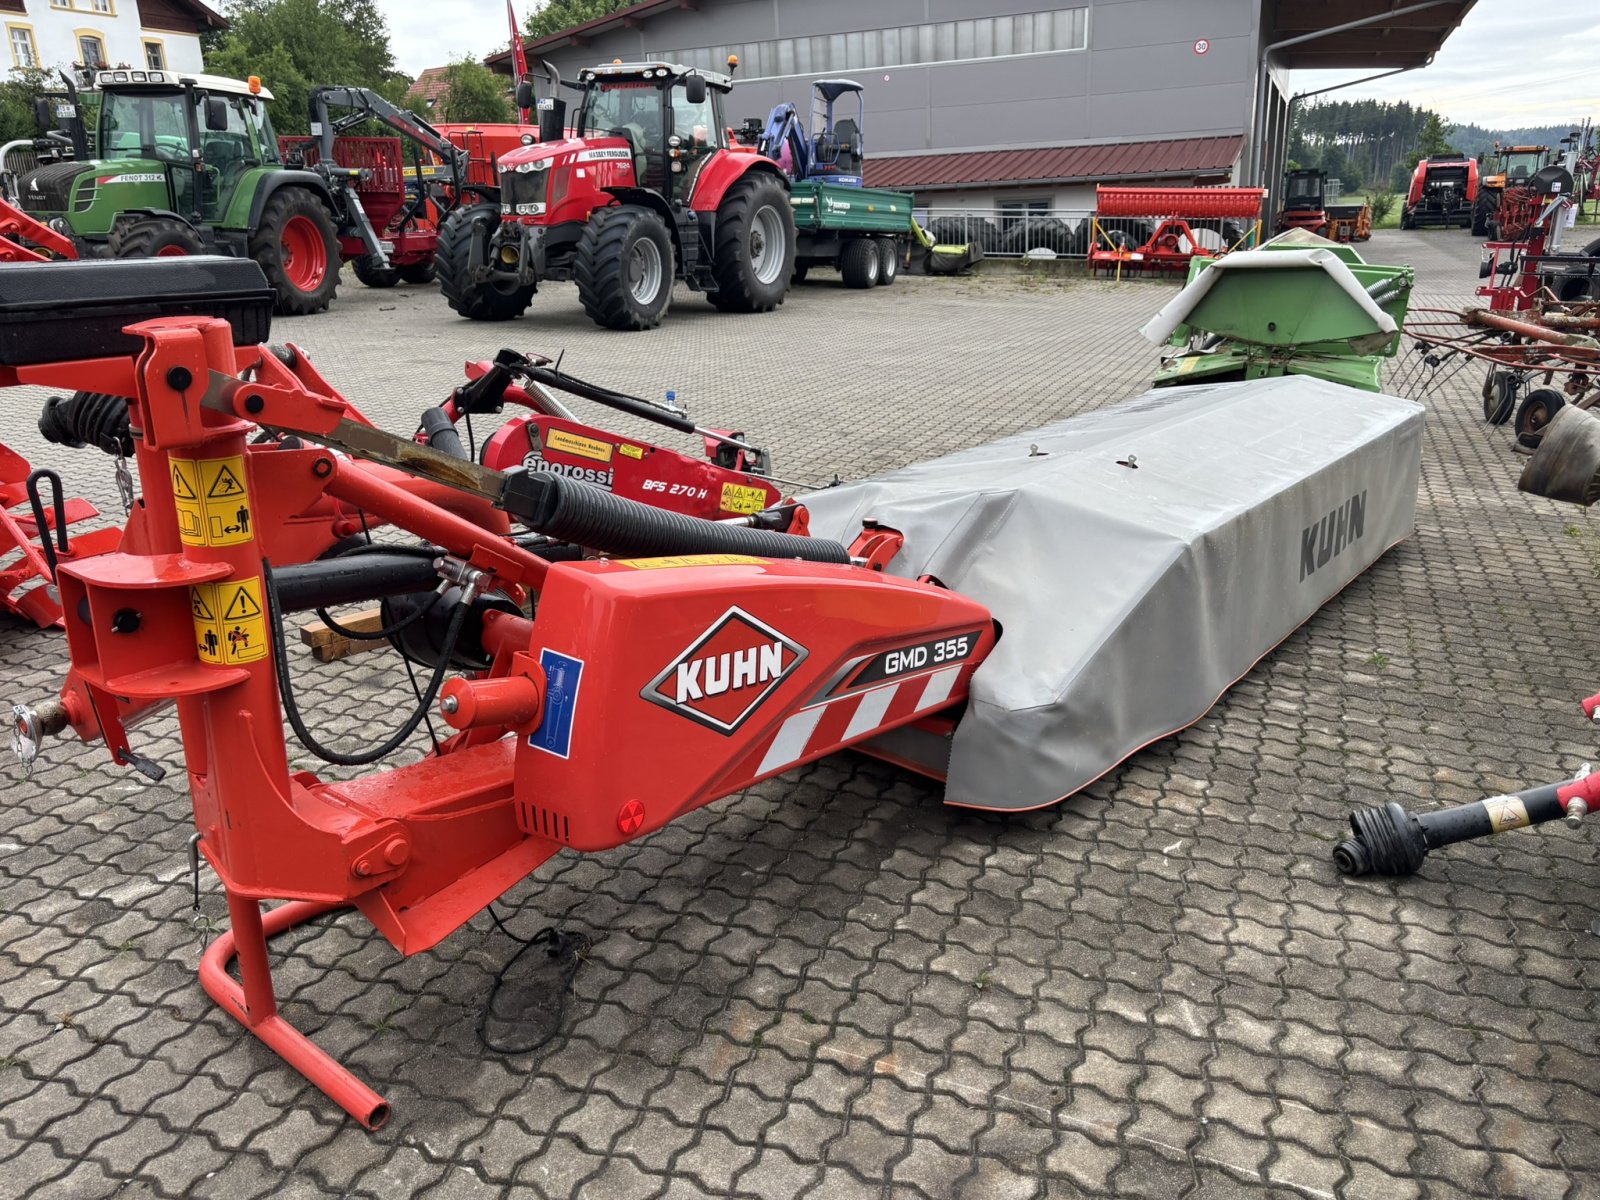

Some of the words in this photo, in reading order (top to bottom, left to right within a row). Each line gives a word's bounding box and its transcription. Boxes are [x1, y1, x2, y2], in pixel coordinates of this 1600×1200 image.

[1197, 42, 1206, 51] 30
[589, 151, 606, 159] MASSEY
[607, 150, 630, 158] FERGUSON
[121, 174, 142, 182] FENDT
[642, 479, 667, 492] BFS
[669, 484, 696, 497] 270
[697, 488, 708, 499] H
[1299, 489, 1367, 584] KUHN
[885, 646, 927, 674] GMD
[933, 636, 968, 662] 355
[676, 641, 782, 704] KUHN
